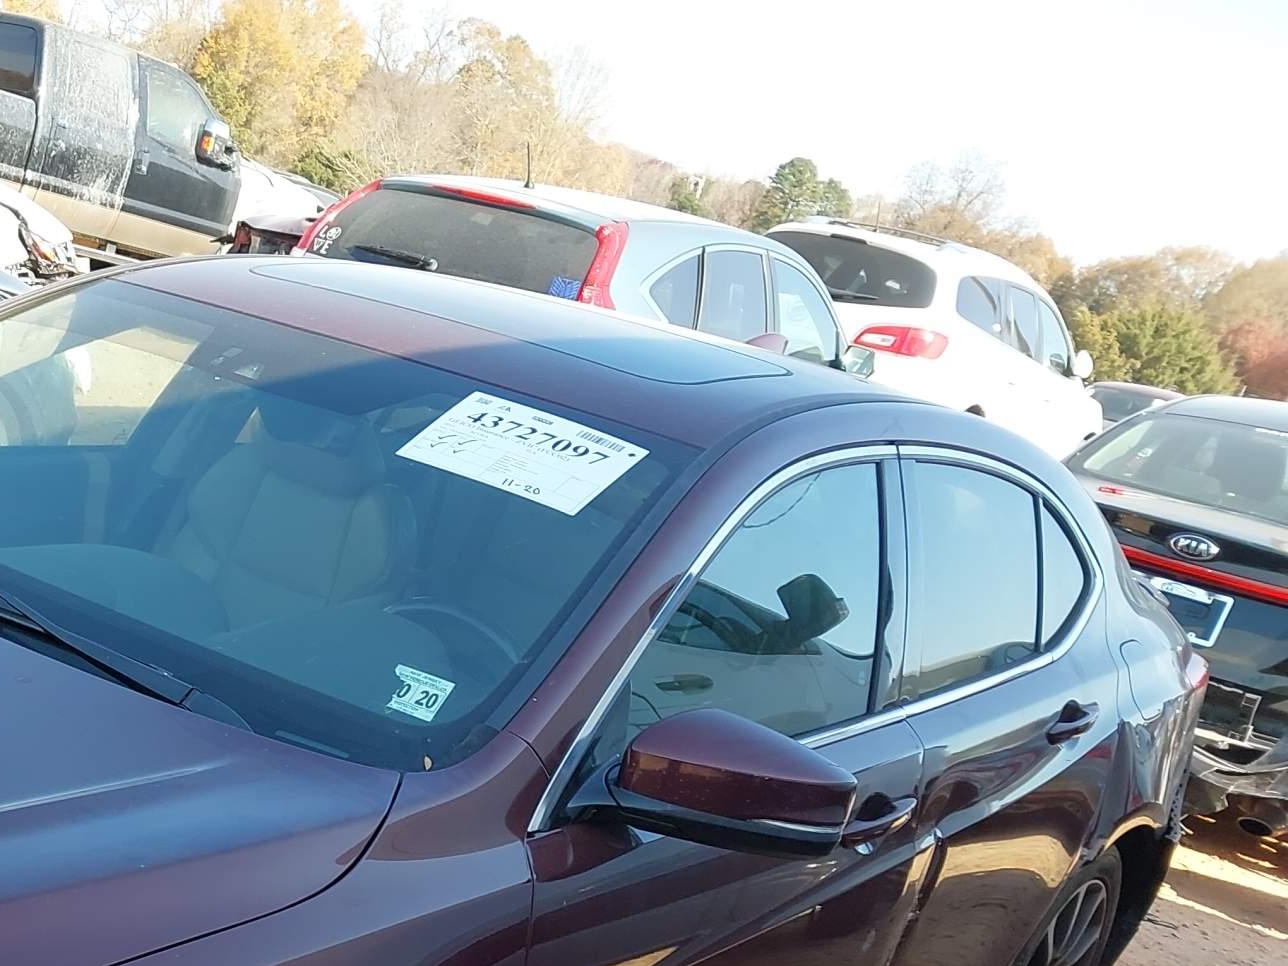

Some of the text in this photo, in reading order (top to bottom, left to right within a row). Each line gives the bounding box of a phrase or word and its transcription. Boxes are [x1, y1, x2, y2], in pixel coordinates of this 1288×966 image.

[467, 412, 611, 464] 43727097
[1175, 537, 1209, 557] KIA
[414, 690, 439, 709] 20
